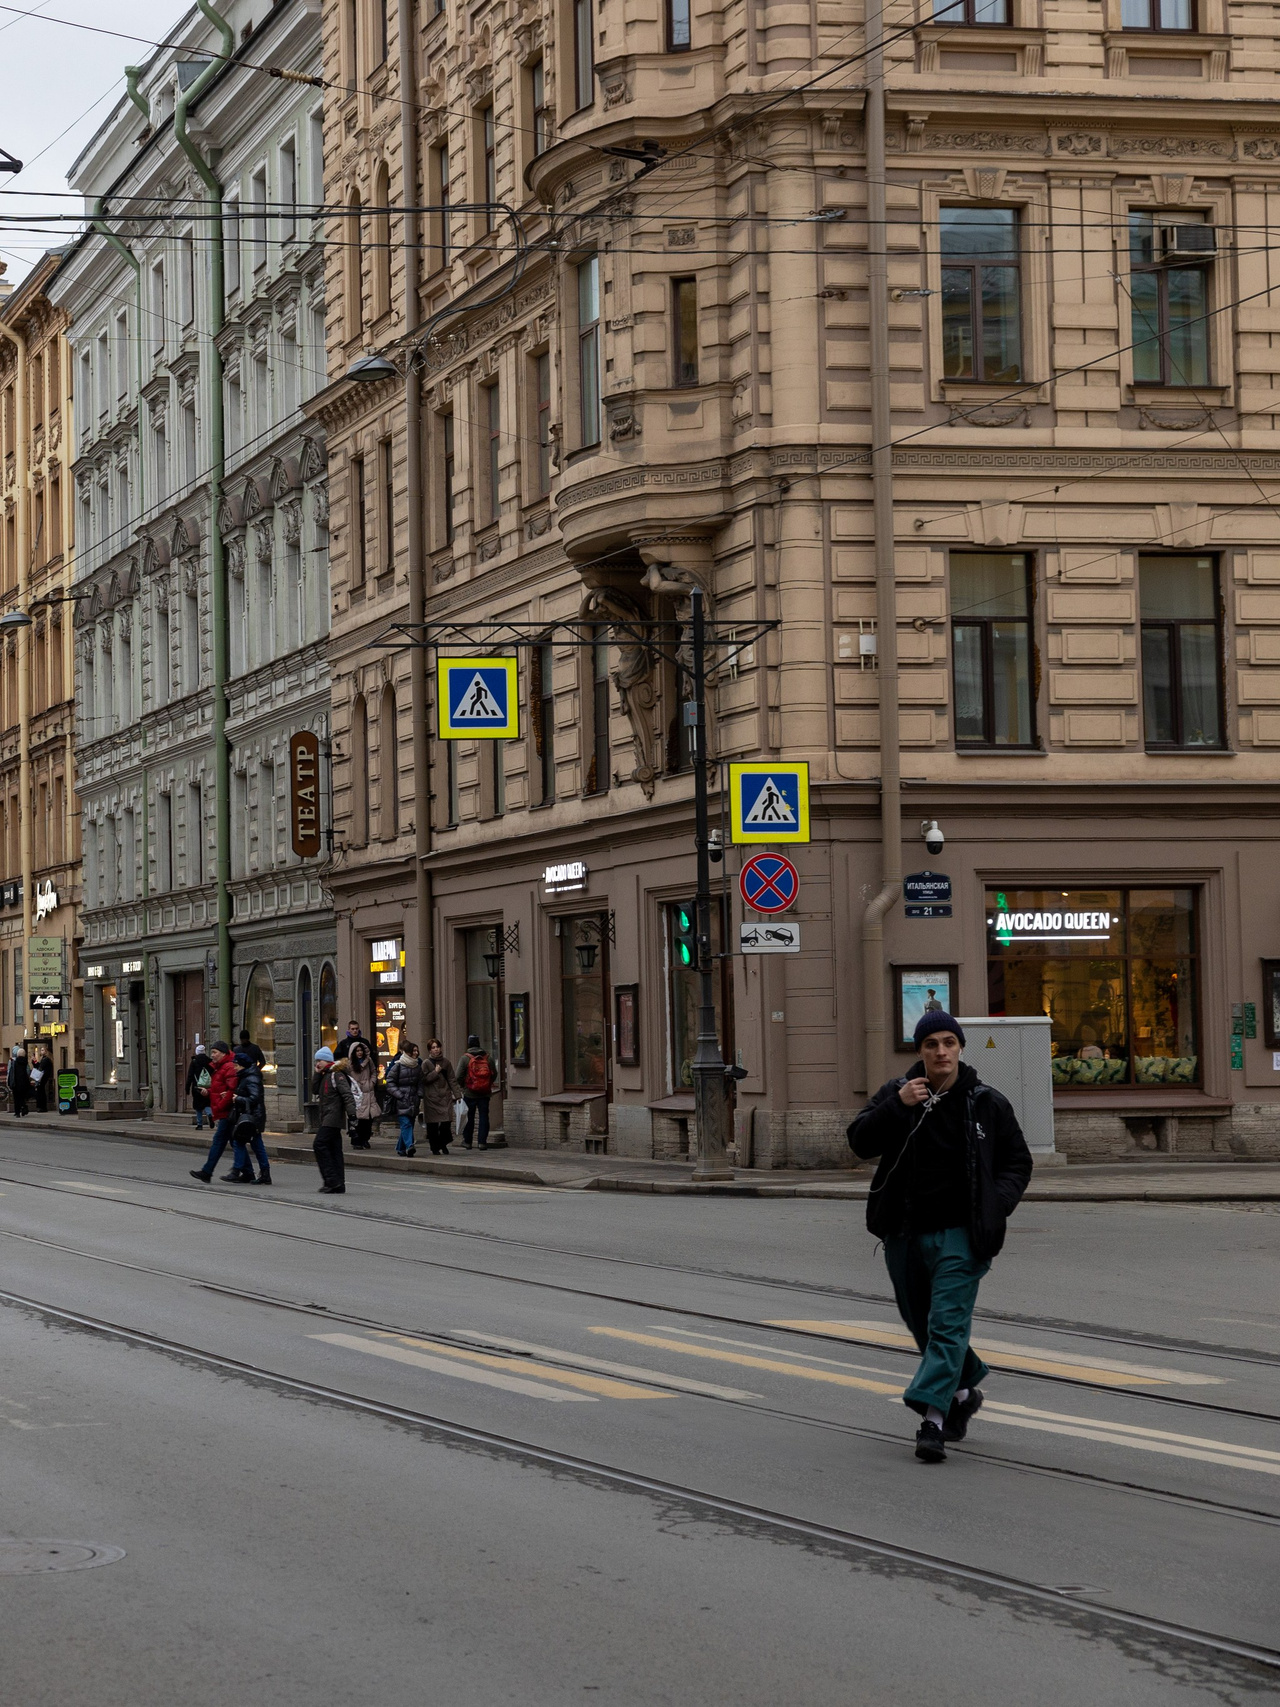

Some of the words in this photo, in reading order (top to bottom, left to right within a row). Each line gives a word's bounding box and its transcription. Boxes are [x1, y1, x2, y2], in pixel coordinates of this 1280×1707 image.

[296, 745, 316, 841] ТЕАТР
[907, 882, 949, 890] ИТАЛЬЯНСКАЯ
[923, 906, 933, 916] 21
[995, 912, 1062, 931] AVOCADO
[1064, 912, 1110, 930] QUEEN
